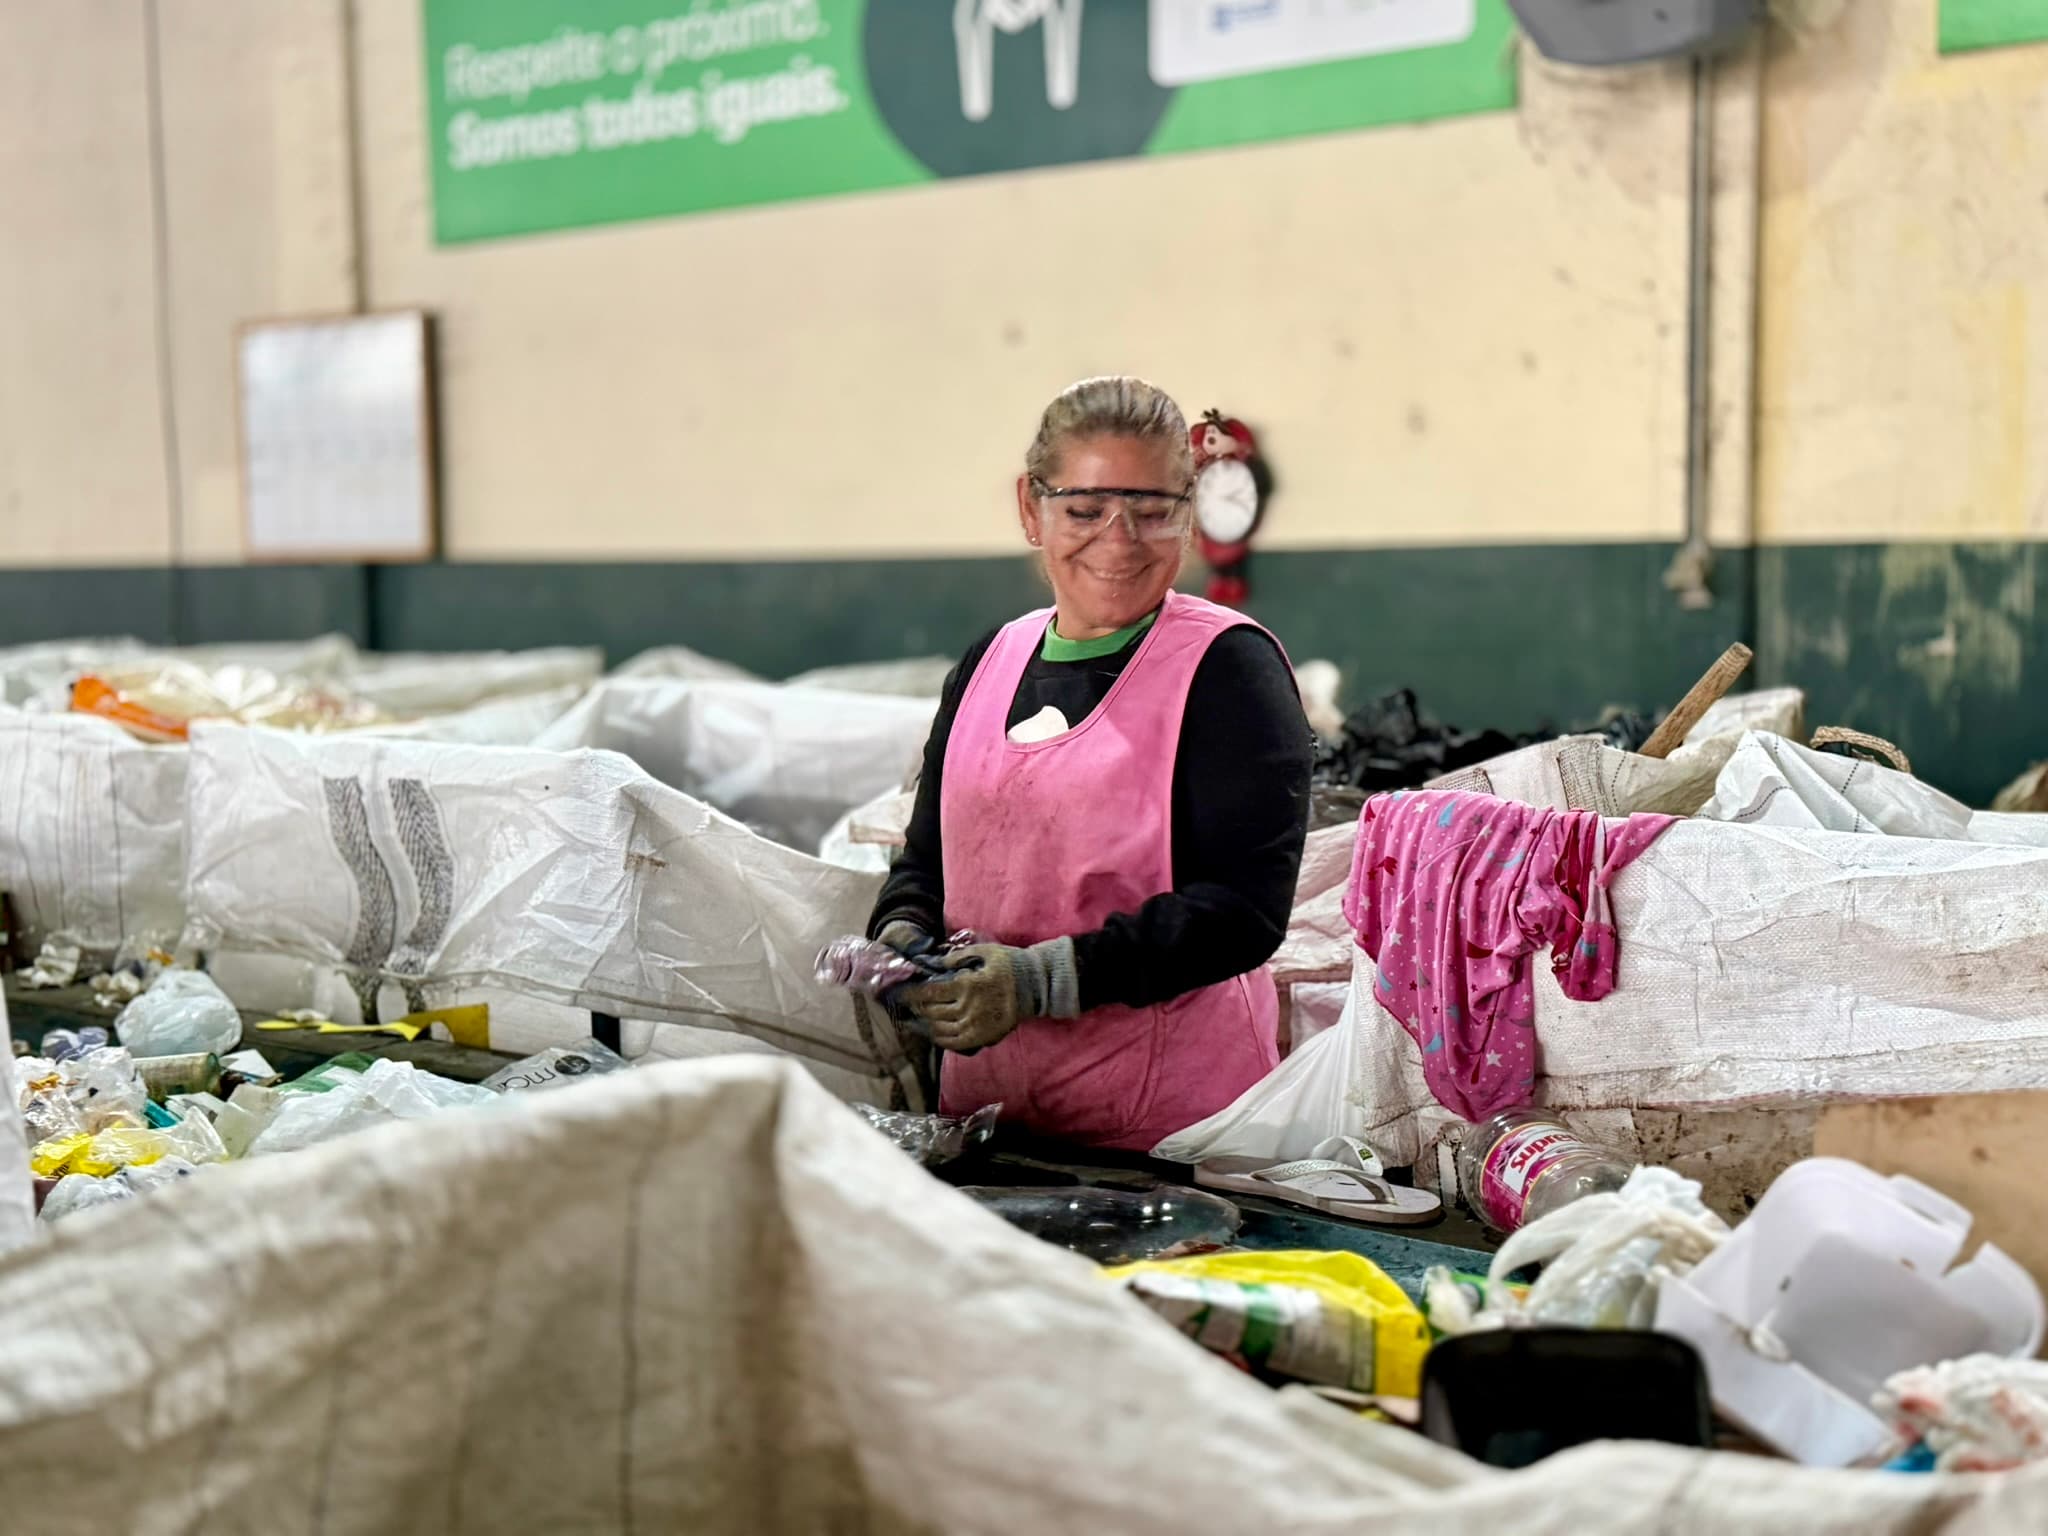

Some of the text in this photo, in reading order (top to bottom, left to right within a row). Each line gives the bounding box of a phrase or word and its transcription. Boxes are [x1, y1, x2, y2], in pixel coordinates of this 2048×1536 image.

[445, 27, 606, 104] Respeite
[610, 25, 641, 74] o
[447, 54, 848, 170] Somos todos iguais.
